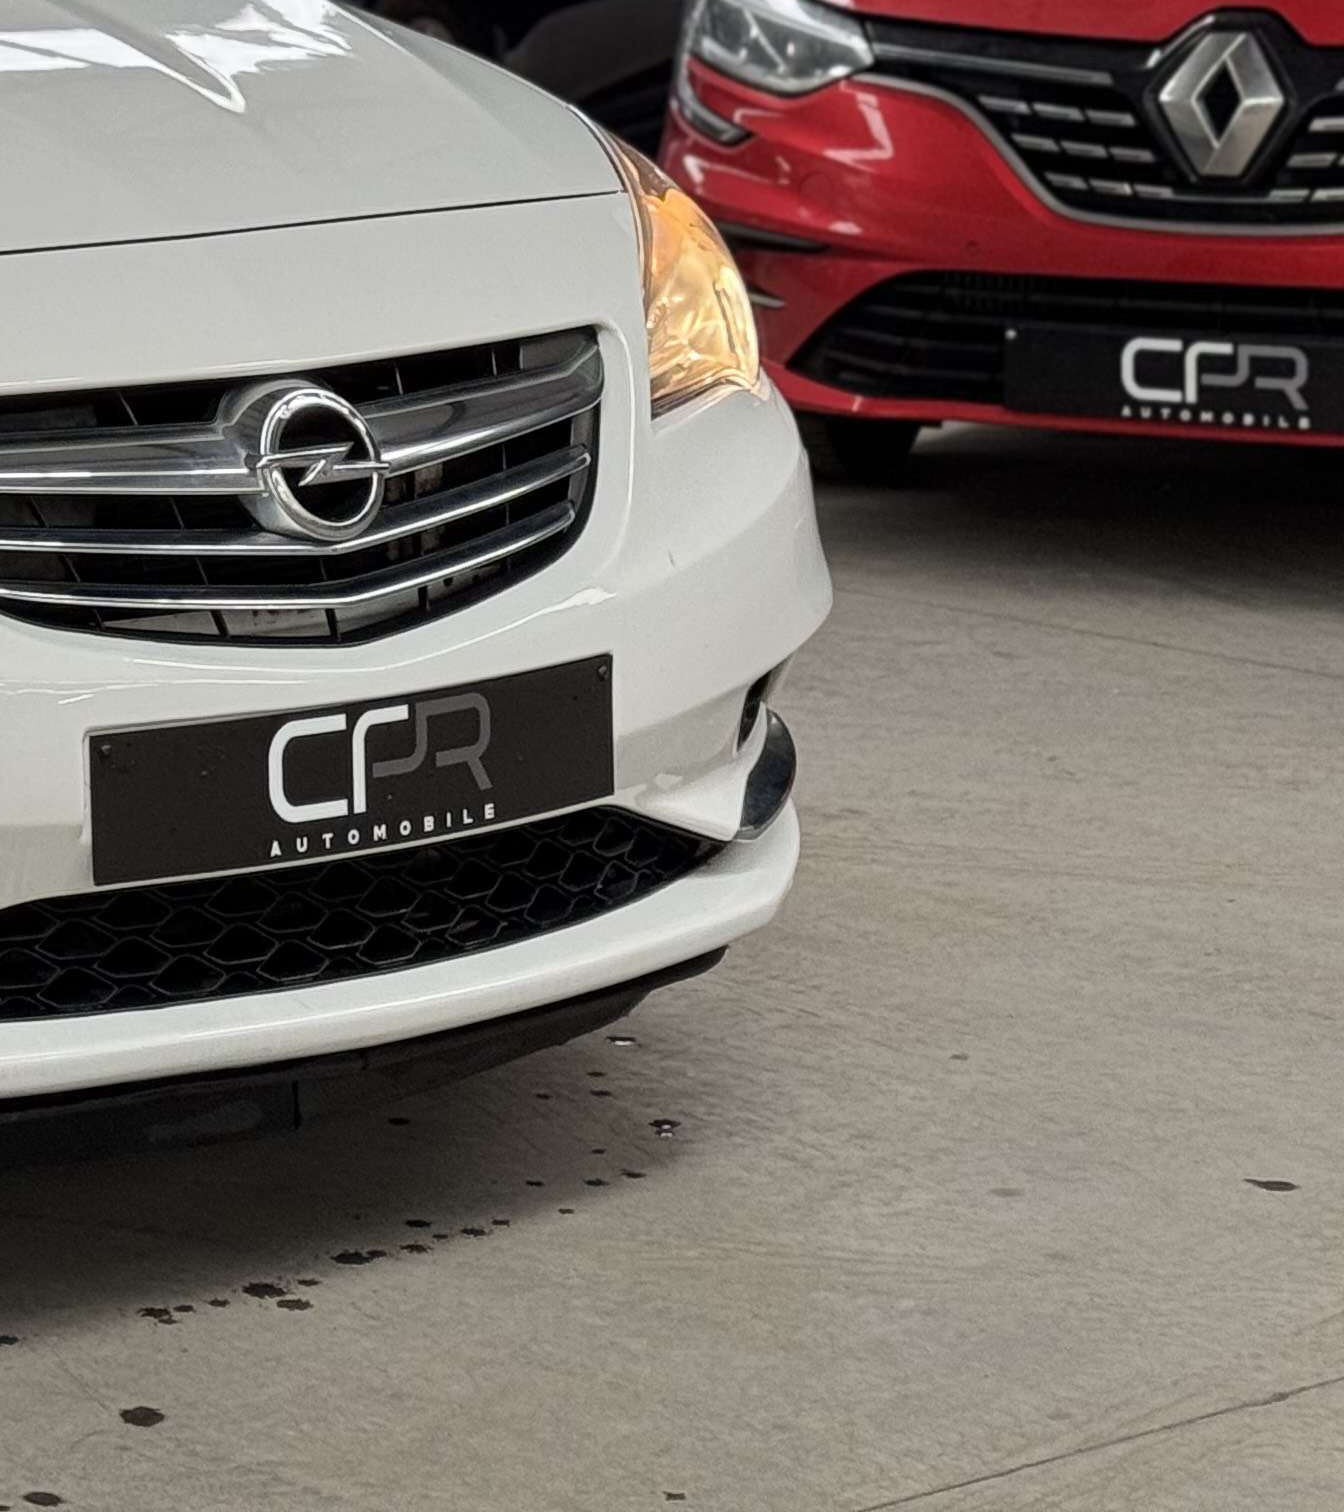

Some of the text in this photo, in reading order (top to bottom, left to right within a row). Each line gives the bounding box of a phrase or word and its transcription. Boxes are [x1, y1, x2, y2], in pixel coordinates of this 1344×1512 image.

[1120, 336, 1310, 411] CPR
[1120, 405, 1312, 430] AUTOMOBILE
[267, 692, 494, 824] CPR
[269, 802, 496, 858] AUTOMOBILE
